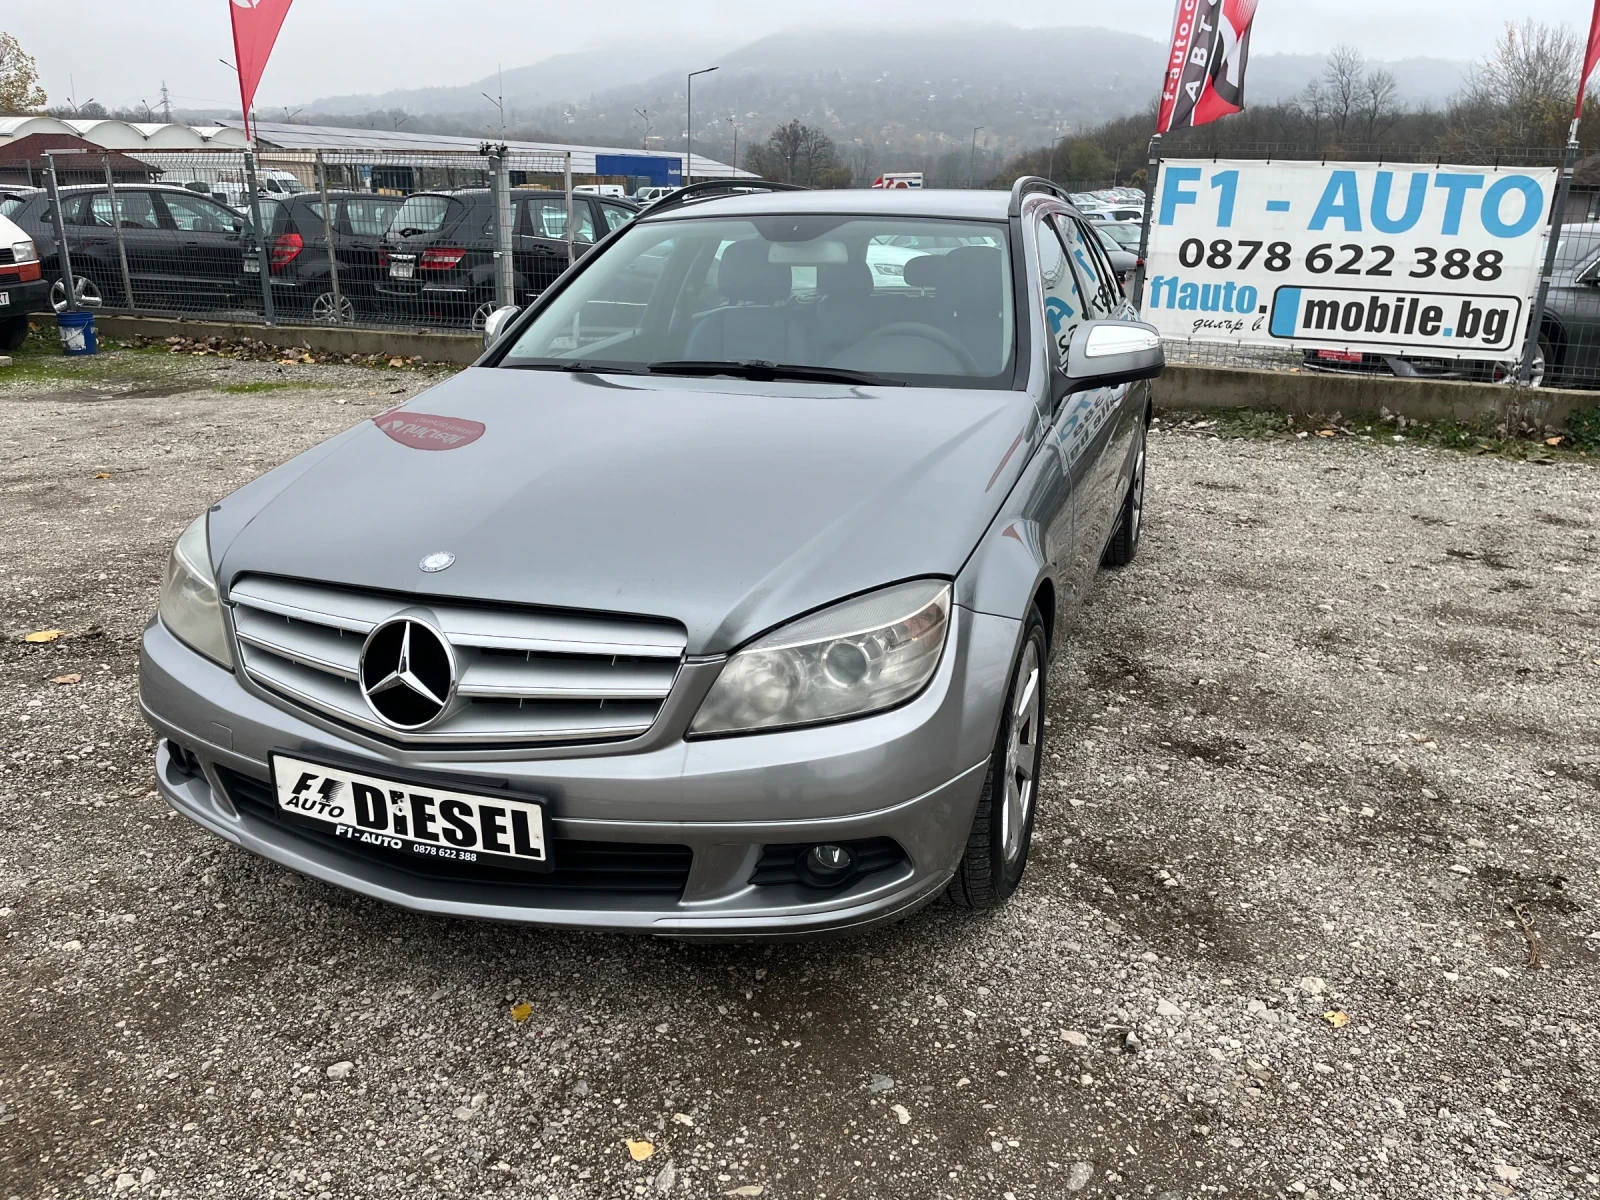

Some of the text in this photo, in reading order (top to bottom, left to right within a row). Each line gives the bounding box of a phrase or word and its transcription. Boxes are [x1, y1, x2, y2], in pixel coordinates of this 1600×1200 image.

[1158, 167, 1239, 228] F1
[1307, 170, 1544, 239] AUTO
[1178, 238, 1503, 282] 0878 622 388
[1303, 295, 1509, 344] mobile.bg
[285, 795, 345, 818] AUTO
[413, 844, 477, 862] 0878 622 388
